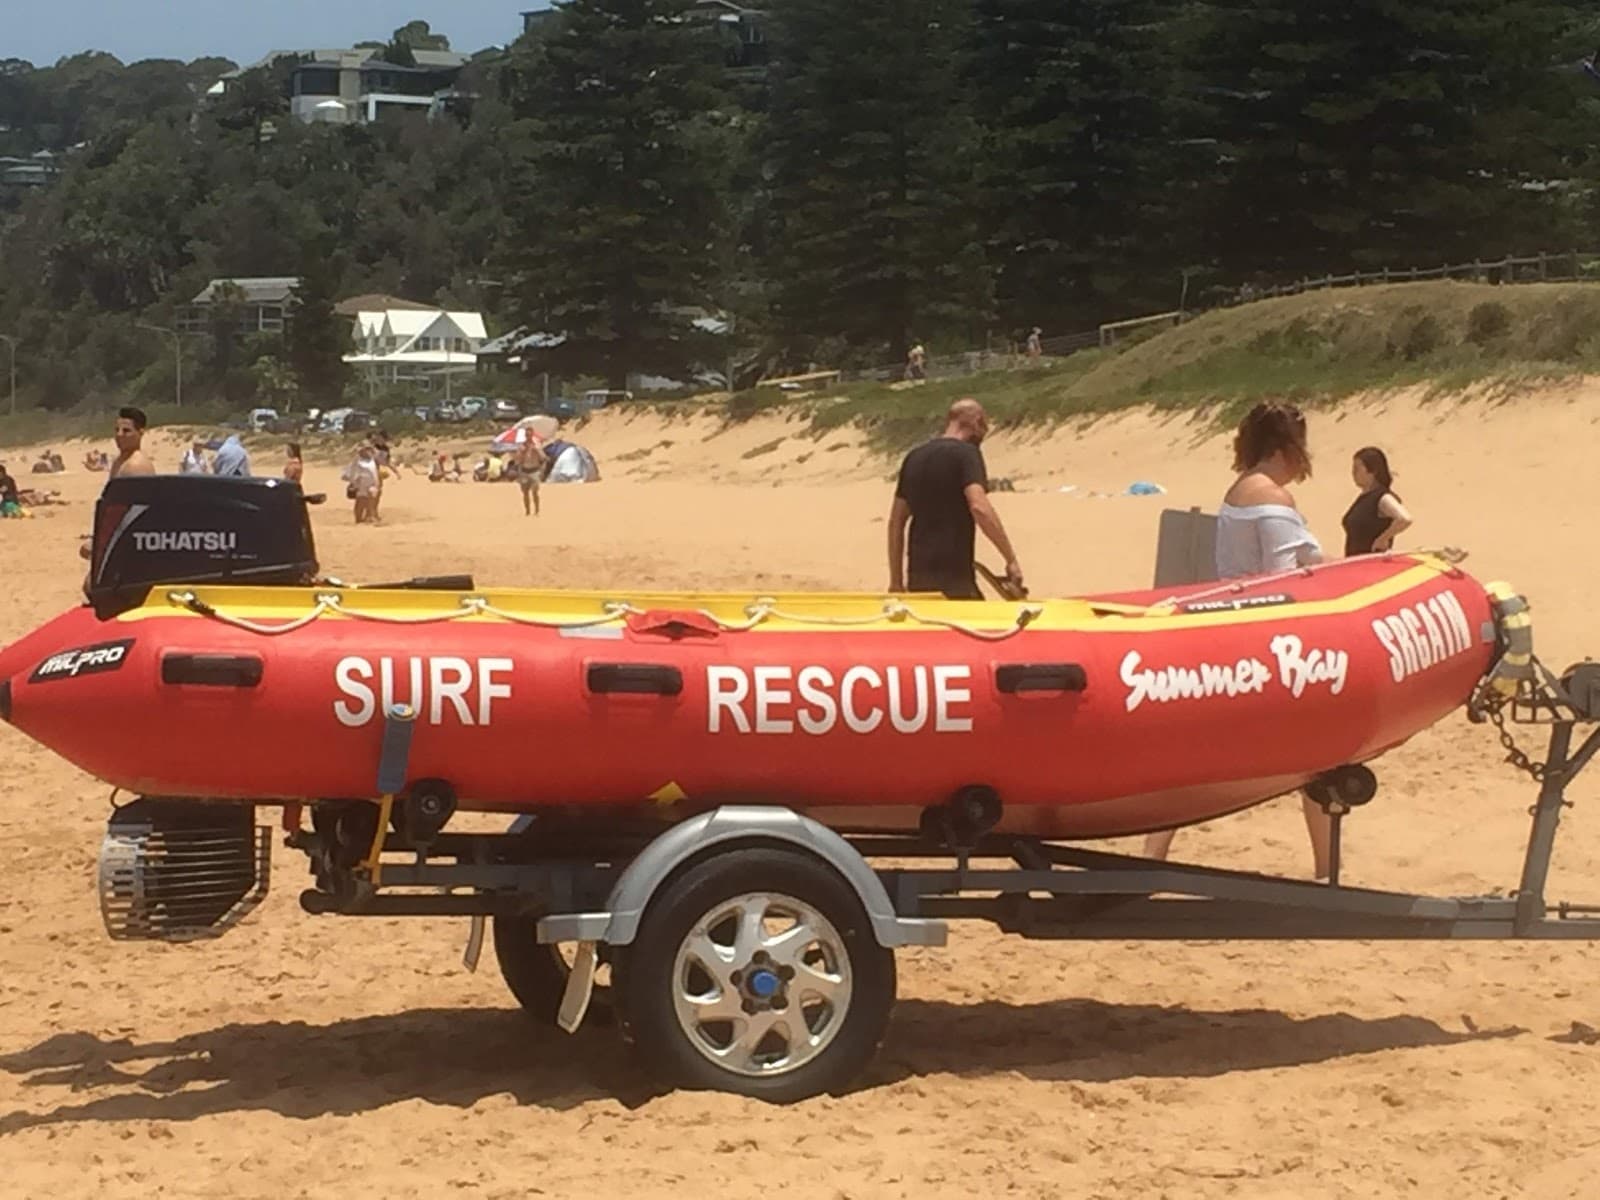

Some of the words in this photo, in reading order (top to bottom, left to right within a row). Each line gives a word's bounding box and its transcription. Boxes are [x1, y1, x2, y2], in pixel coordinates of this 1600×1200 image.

[132, 531, 237, 551] TOHATSU
[333, 655, 514, 727] SURF
[706, 664, 973, 735] RESCUE
[1119, 650, 1272, 713] Summer
[1269, 633, 1349, 699] Bay
